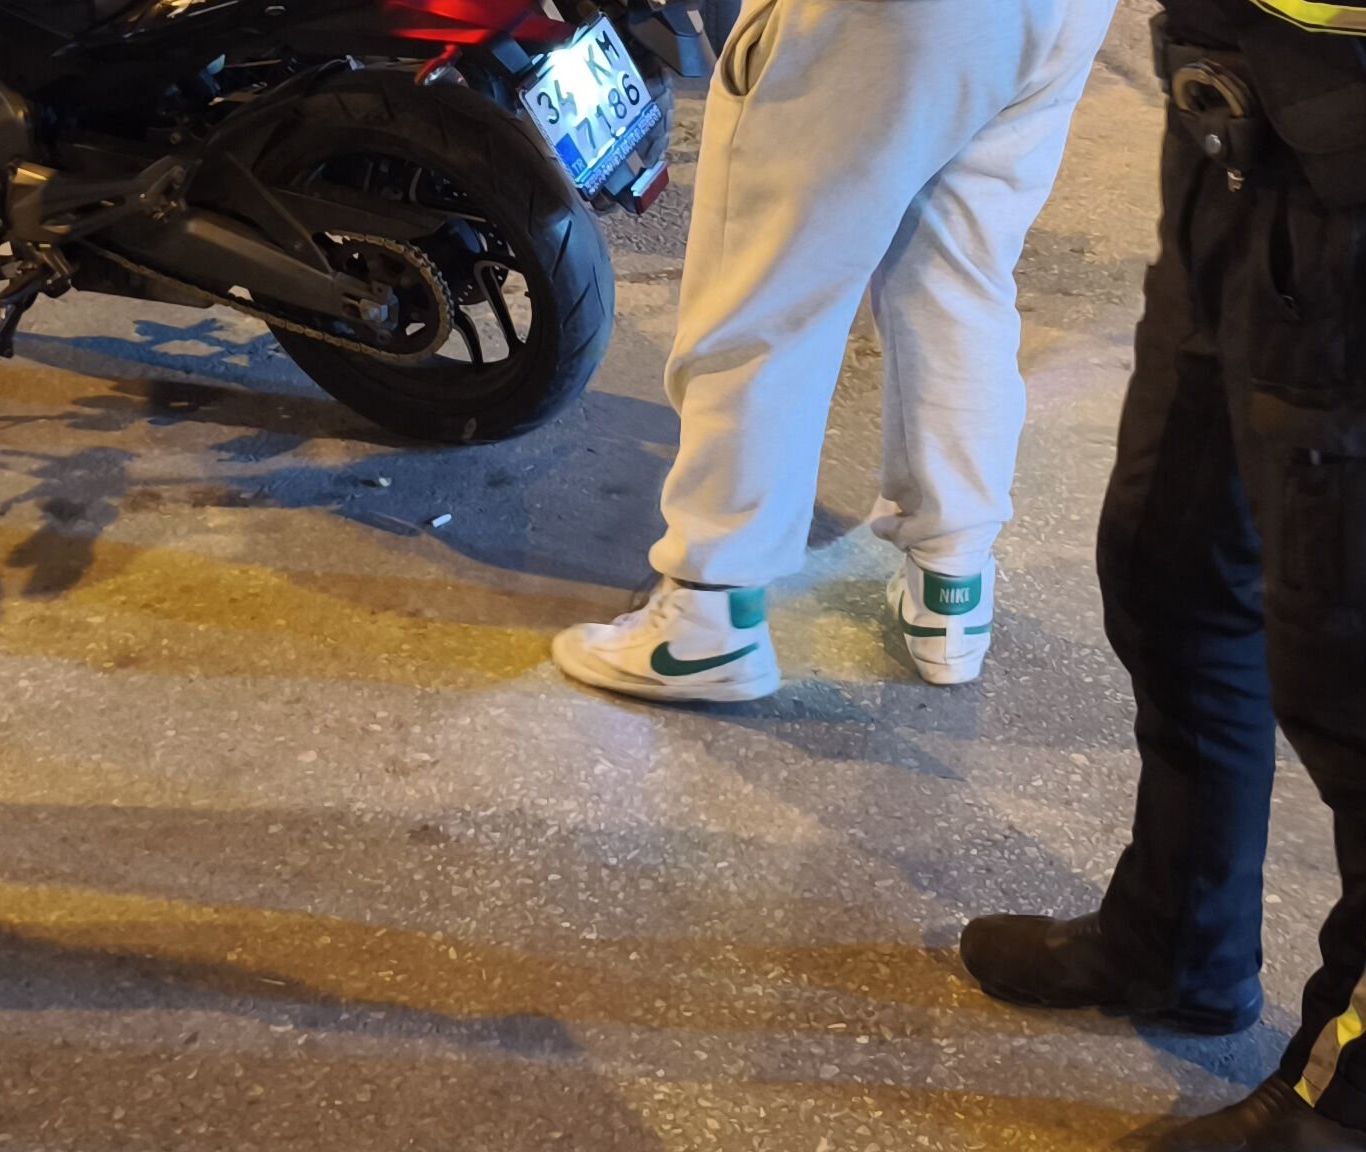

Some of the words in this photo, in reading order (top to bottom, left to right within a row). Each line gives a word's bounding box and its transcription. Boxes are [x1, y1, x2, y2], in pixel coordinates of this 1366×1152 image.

[537, 79, 578, 125] 34
[584, 30, 621, 86] KM
[575, 73, 640, 149] 7186
[571, 159, 586, 173] TR
